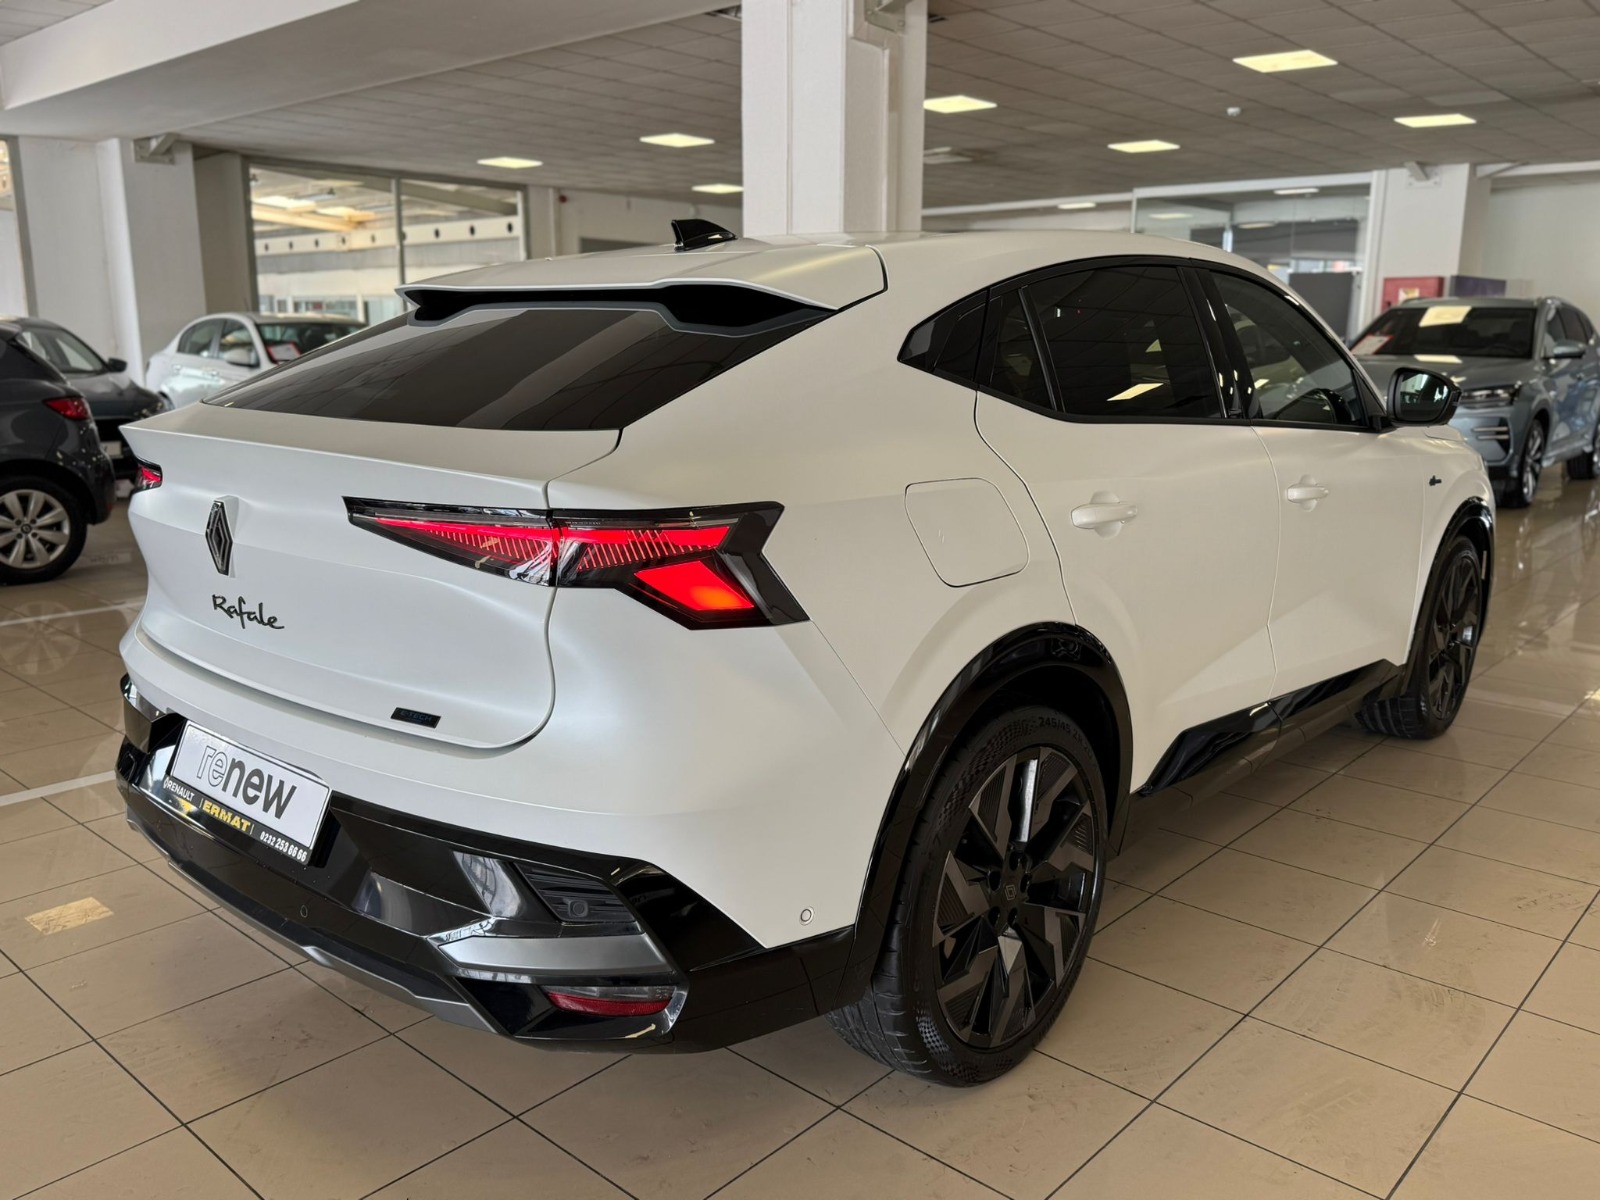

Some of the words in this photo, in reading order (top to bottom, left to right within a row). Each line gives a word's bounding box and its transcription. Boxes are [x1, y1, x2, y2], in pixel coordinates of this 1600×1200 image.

[212, 594, 285, 629] Rafale
[196, 745, 297, 820] renew
[167, 781, 195, 802] RENAULT
[203, 799, 251, 832] ERMAT
[274, 837, 290, 853] 253
[288, 844, 299, 857] 66
[296, 849, 308, 862] 66
